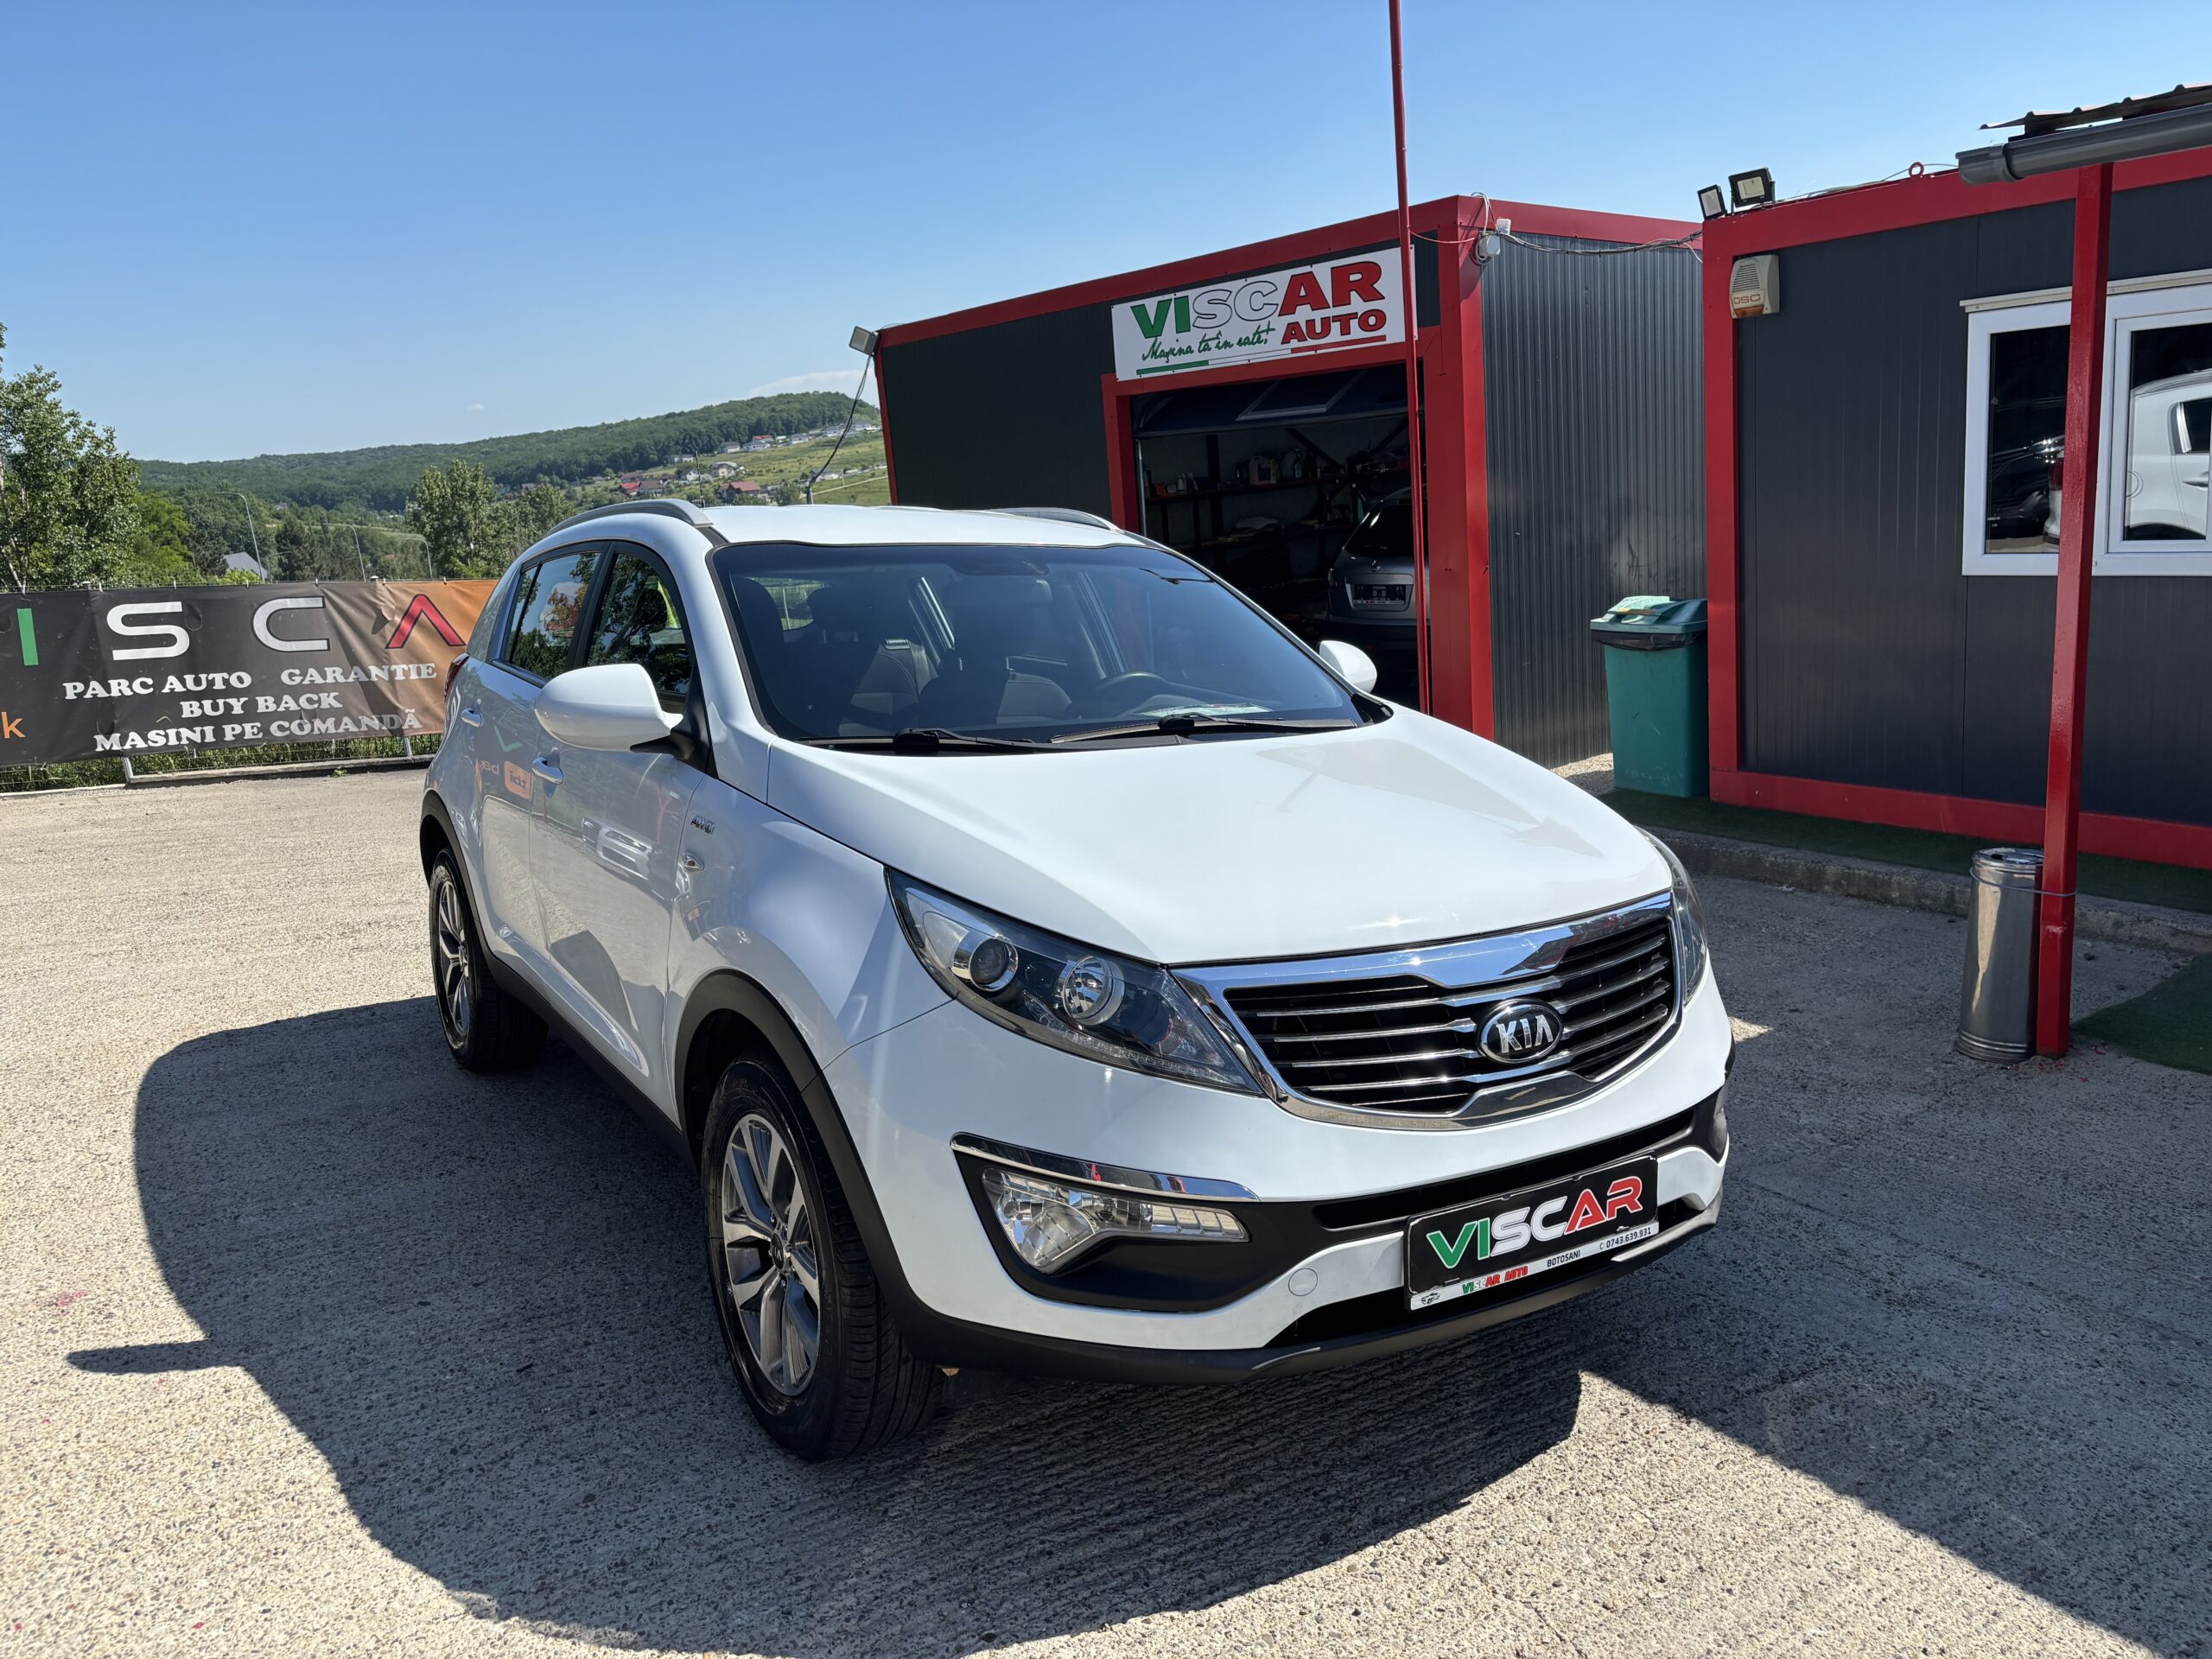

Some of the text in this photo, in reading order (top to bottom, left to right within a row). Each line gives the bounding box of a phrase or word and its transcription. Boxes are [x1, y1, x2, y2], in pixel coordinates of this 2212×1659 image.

[1130, 261, 1385, 339] VISCAR
[1733, 294, 1761, 304] DSC
[1281, 309, 1387, 345] AUTO
[62, 671, 252, 700] PARC AUTO
[281, 663, 437, 685] GARANTIE
[180, 692, 343, 718] BUY BACK
[93, 726, 216, 752] MASINI
[222, 722, 264, 741] PE
[1496, 1014, 1554, 1054] KIA
[1426, 1175, 1643, 1269] VISCAR
[1606, 1227, 1651, 1249] 0743.639.931
[1547, 1249, 1581, 1268] BOTOSANI
[1461, 1265, 1529, 1294] VISCAR AUTO
